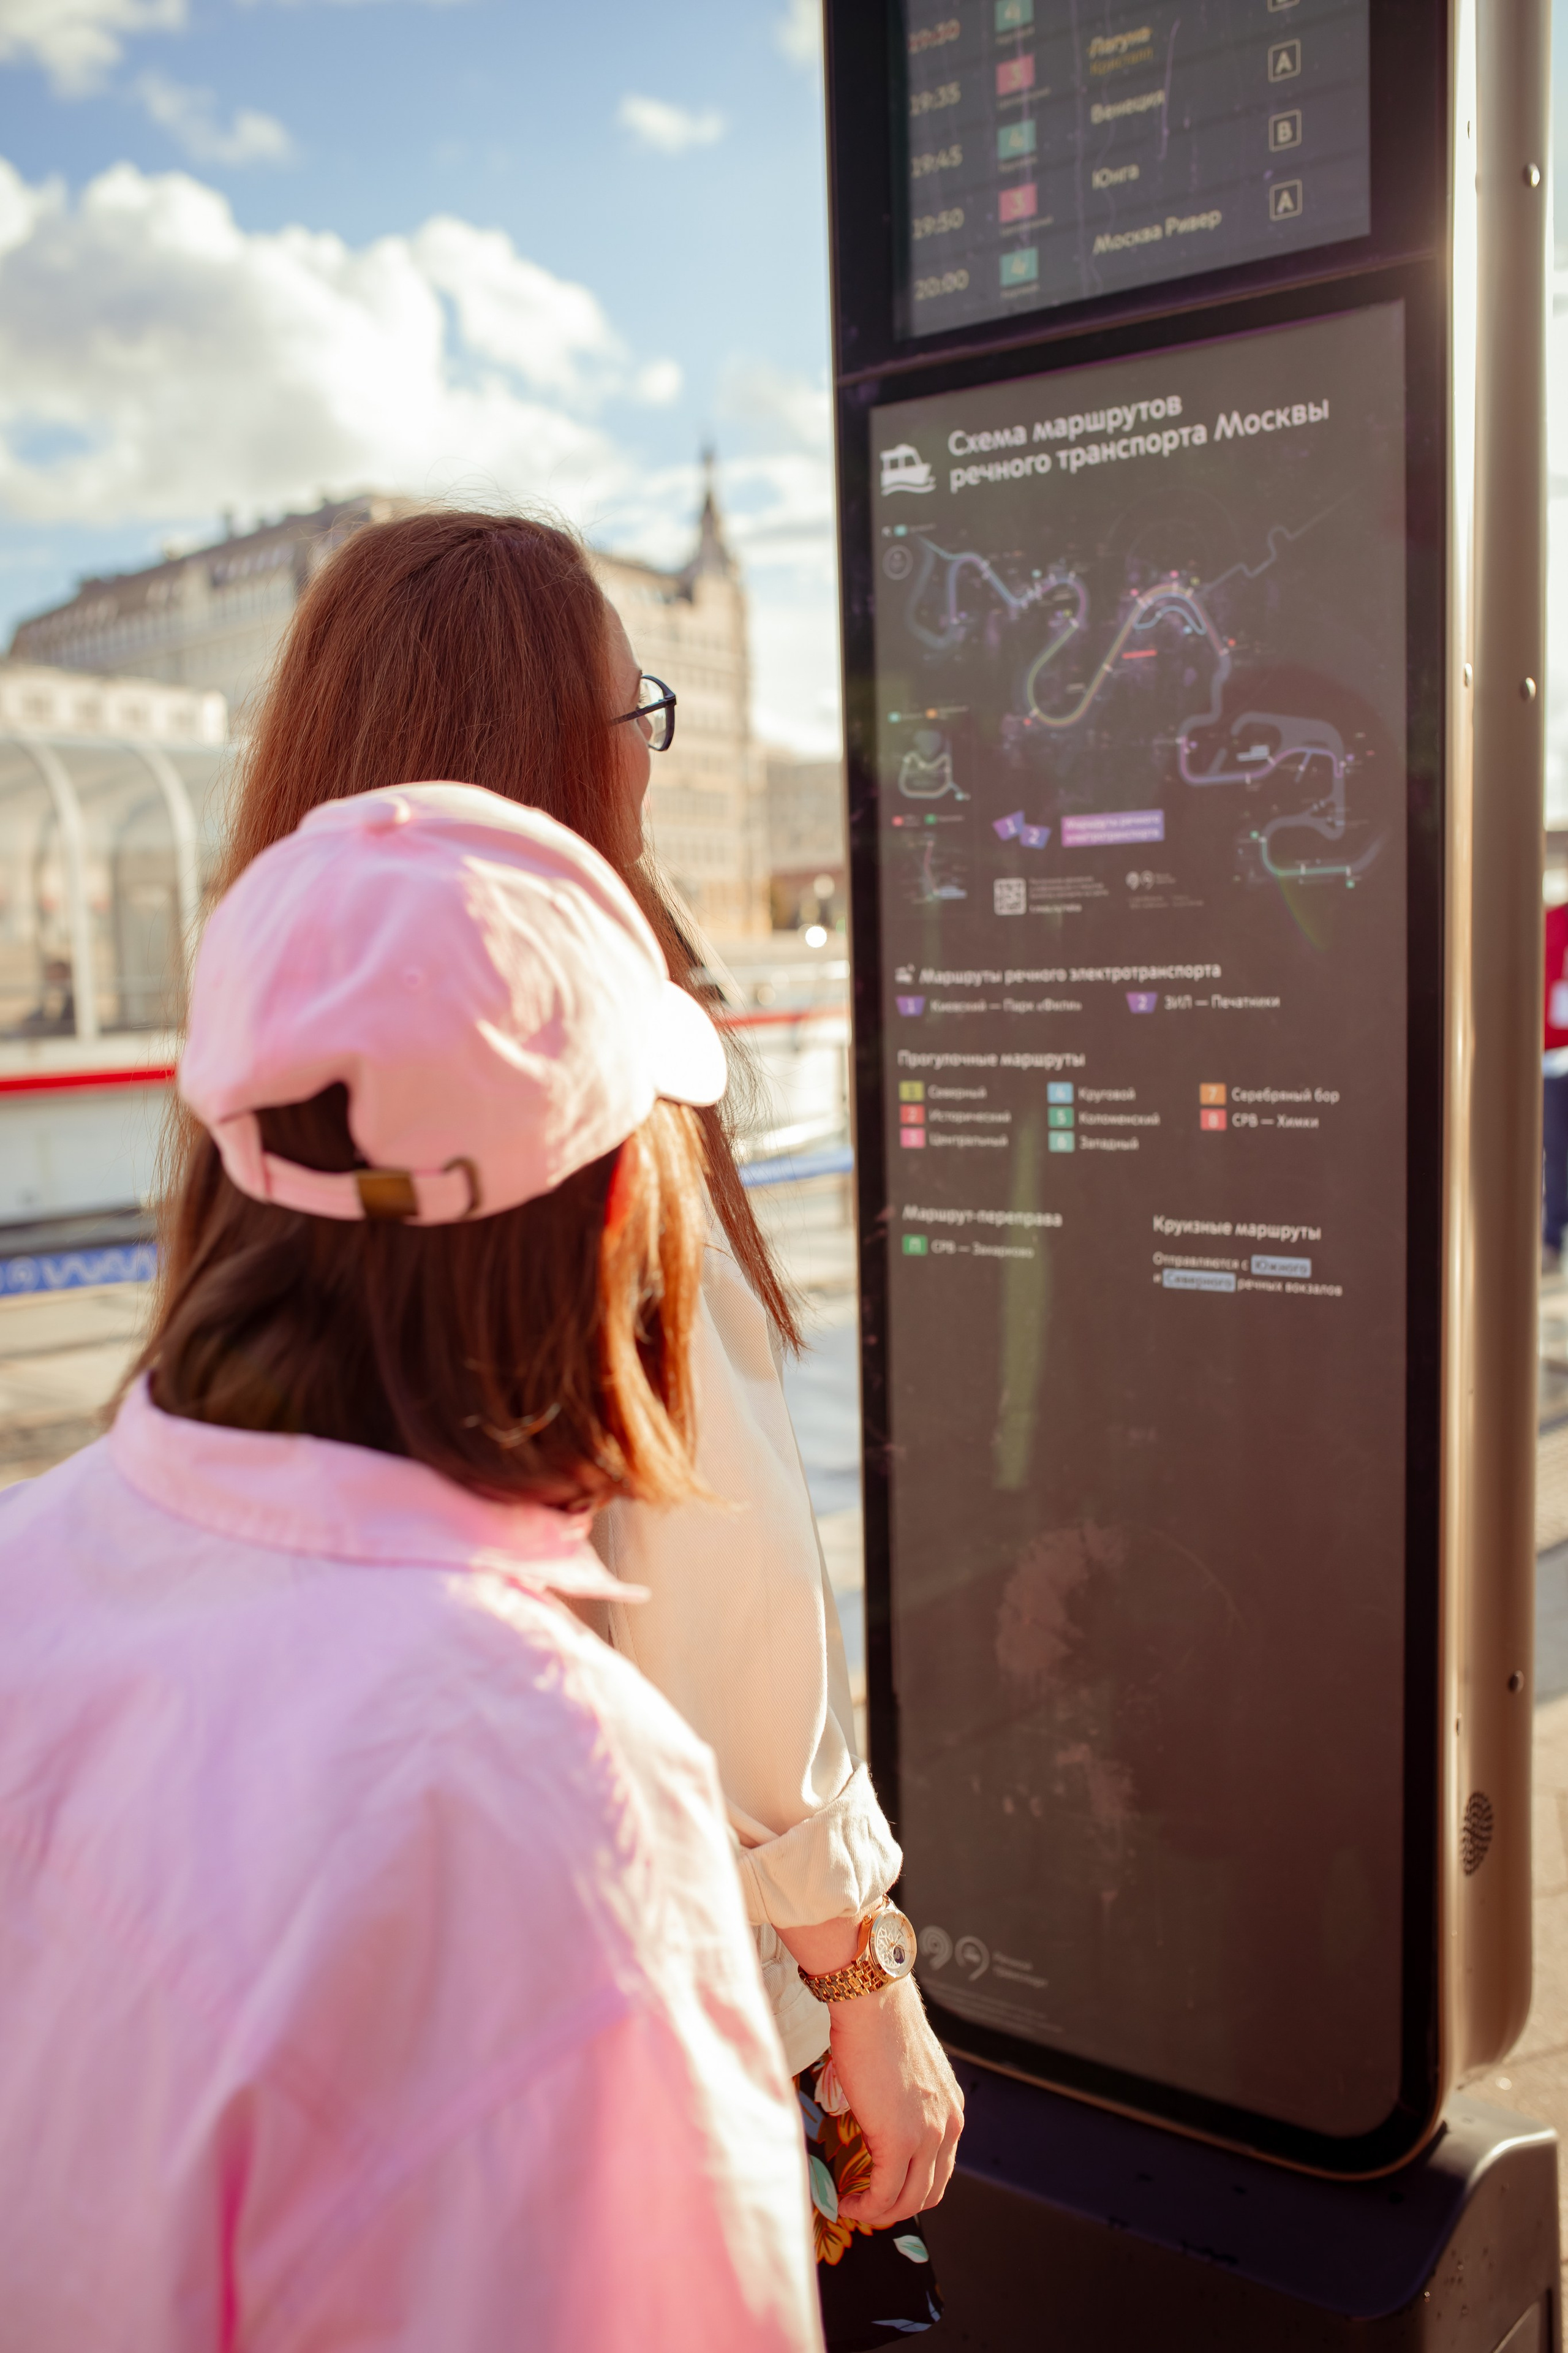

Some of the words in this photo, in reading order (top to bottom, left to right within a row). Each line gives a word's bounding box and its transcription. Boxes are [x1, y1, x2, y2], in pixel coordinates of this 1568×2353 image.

[1008, 64, 1022, 88] 3
[910, 81, 961, 116] 19:35
[1091, 89, 1165, 124] Венеция
[911, 144, 962, 178] 19:45
[1092, 164, 1139, 190] Юнга
[1011, 191, 1025, 214] 3
[912, 207, 964, 240] 19:50
[1092, 224, 1163, 255] Москва
[1165, 210, 1222, 237] Ривер
[914, 268, 969, 301] 20:00
[948, 425, 1027, 456] Схема
[1033, 395, 1182, 442] маршрутов
[950, 453, 1052, 494] речного
[1055, 423, 1208, 475] транспорта
[1213, 398, 1329, 442] Москвы
[1028, 827, 1041, 845] 2
[919, 967, 1003, 987] Маршруты
[1005, 967, 1067, 986] речного
[1068, 963, 1222, 984] электротранспорта
[1137, 993, 1148, 1011] 2
[1164, 994, 1193, 1010] ЗИЛ
[1211, 993, 1281, 1010] Печатники
[897, 1049, 999, 1070] Прогулочные
[1000, 1052, 1086, 1071] маршруты
[1208, 1086, 1218, 1101] 7
[1231, 1086, 1312, 1105] Серебряный
[1314, 1087, 1341, 1105] бор
[1208, 1112, 1219, 1128] 8
[1231, 1112, 1259, 1128] СРВ
[1276, 1113, 1319, 1128] Химки
[902, 1204, 1063, 1229] Маршрут-переправа
[1153, 1214, 1233, 1237] Круизные
[1234, 1222, 1321, 1243] маршруты
[1284, 1282, 1344, 1297] вокзалов
